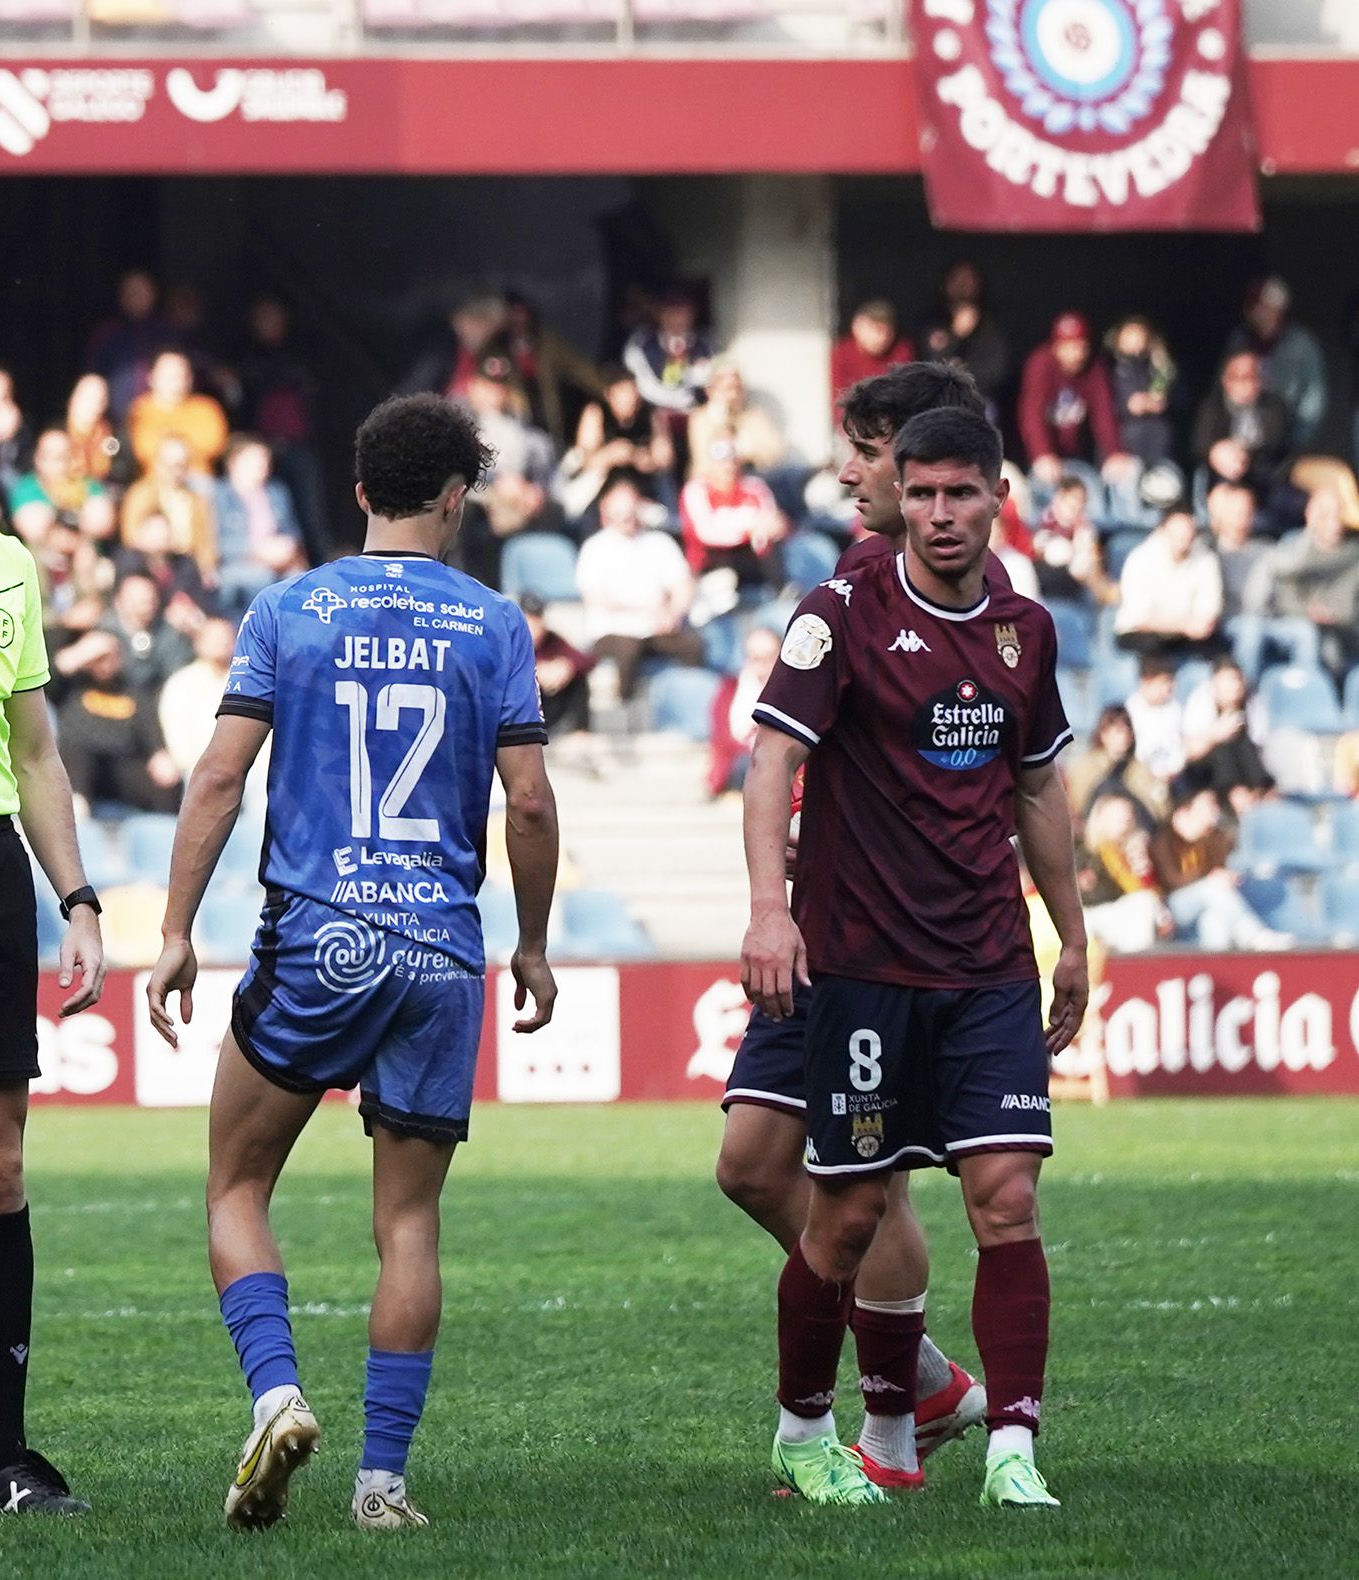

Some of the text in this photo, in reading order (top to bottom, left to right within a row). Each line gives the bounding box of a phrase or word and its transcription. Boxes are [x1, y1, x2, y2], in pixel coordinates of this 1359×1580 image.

[350, 584, 411, 594] HOSPITAL
[351, 592, 484, 620] recoletas salud
[413, 617, 484, 636] EL CARMEN
[334, 635, 451, 672] JELBAT
[931, 702, 1004, 725] Estrella
[932, 725, 1000, 747] Galicia
[335, 680, 447, 842] 12
[360, 846, 443, 871] Levagalia
[362, 912, 420, 927] XUNTA
[393, 928, 450, 942] ALICIA
[848, 1028, 883, 1092] 8
[848, 1093, 881, 1103] XUNTA
[848, 1098, 898, 1112] DE GALICIA
